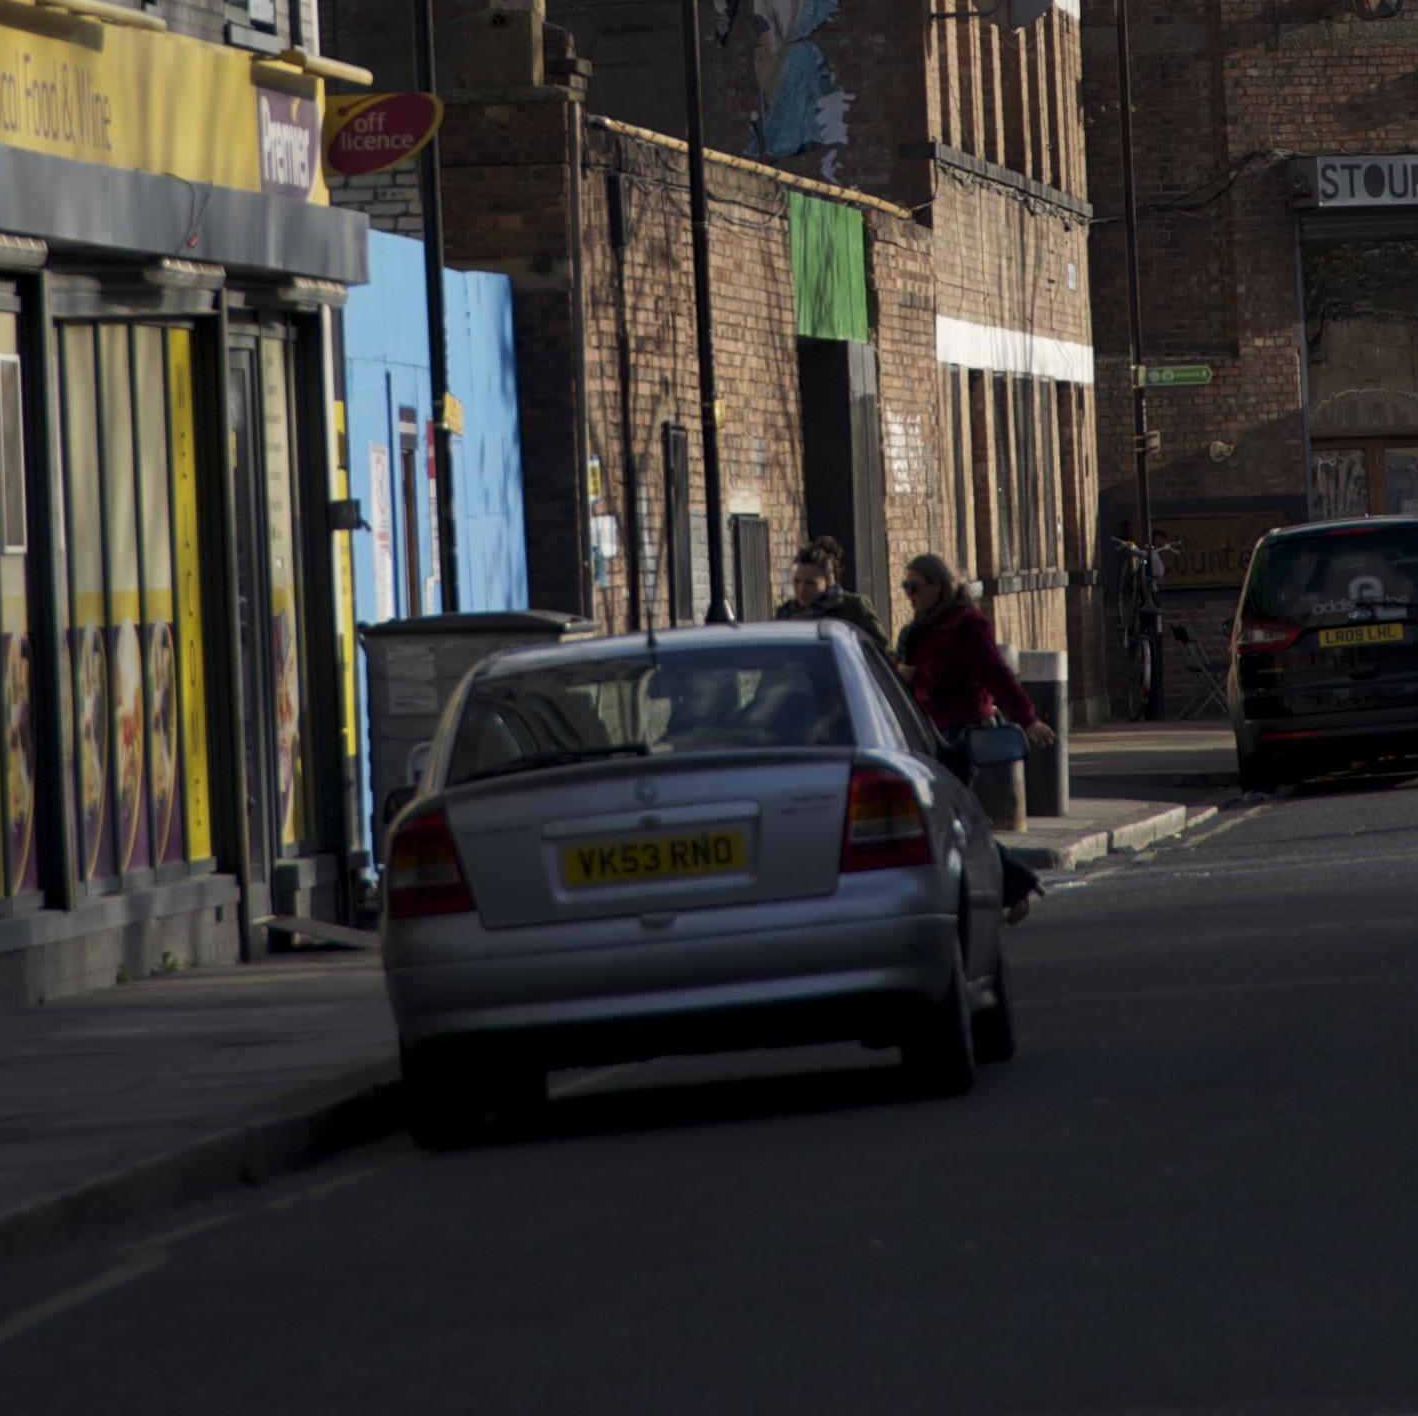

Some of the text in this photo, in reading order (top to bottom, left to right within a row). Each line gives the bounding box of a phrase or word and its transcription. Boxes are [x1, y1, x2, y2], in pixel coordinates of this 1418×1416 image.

[24, 52, 59, 140] Food
[62, 62, 76, 144] &
[75, 65, 112, 152] Wine
[353, 111, 387, 133] off
[260, 95, 310, 188] Premier
[338, 129, 416, 152] licence
[176, 363, 202, 828] WELCOME
[1325, 625, 1397, 644] LR09 LHL
[577, 836, 733, 876] VK53 RNO
